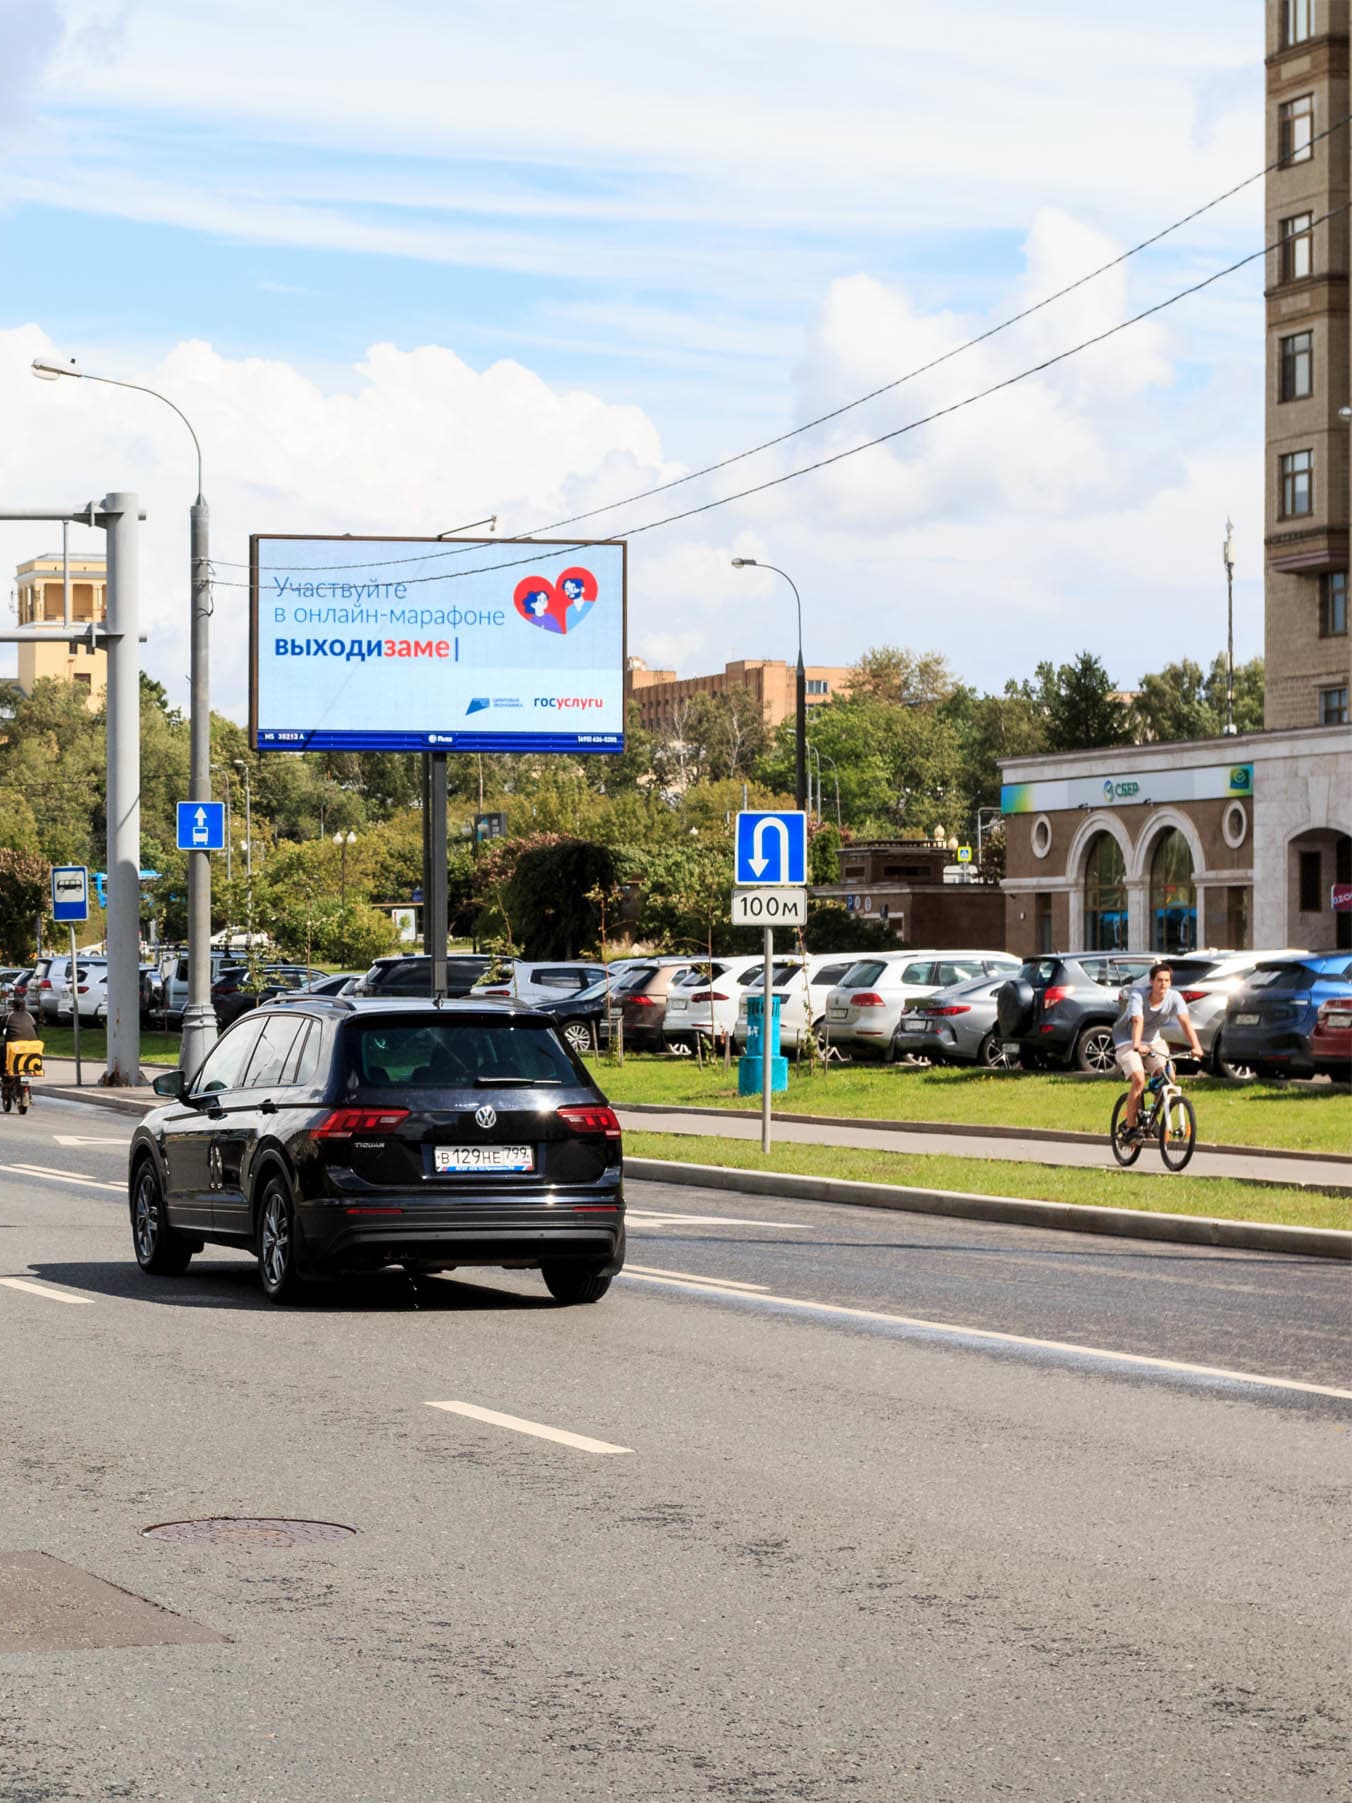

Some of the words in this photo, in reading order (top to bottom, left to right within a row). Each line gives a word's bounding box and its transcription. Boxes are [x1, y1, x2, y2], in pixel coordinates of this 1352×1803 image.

[273, 576, 408, 602] Участвуйте
[274, 607, 286, 623] в
[294, 602, 505, 629] онлайн-марафоне
[534, 697, 604, 711] госуслуги
